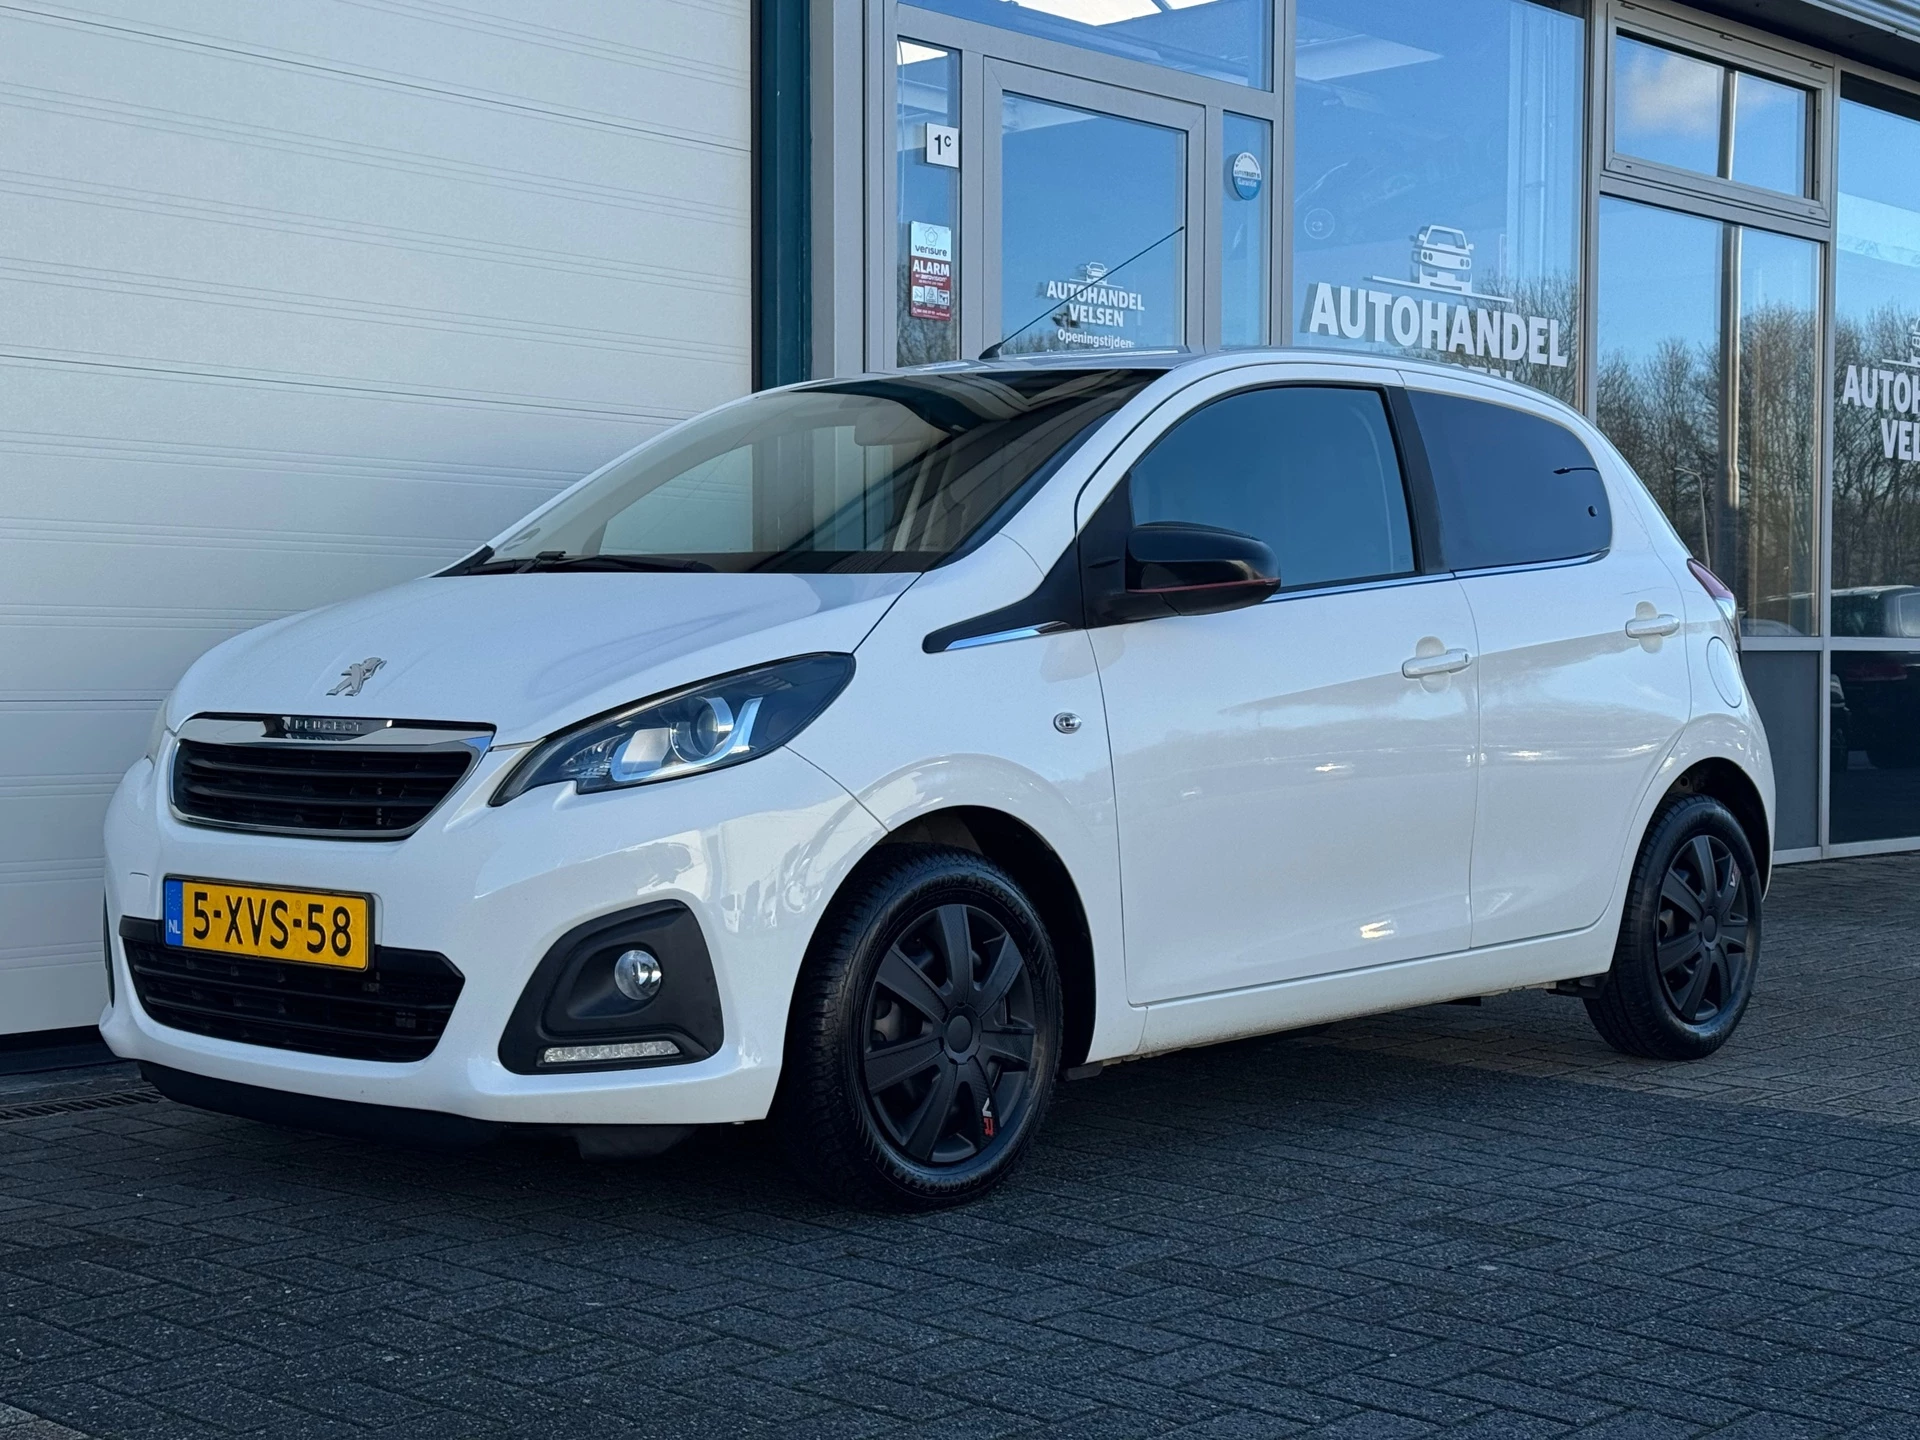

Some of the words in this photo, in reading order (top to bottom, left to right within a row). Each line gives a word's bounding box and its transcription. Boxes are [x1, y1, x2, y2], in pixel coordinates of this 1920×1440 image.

[914, 244, 948, 257] verisure
[912, 259, 950, 277] ALARM
[1046, 280, 1145, 311] AUTOHANDEL
[1069, 303, 1124, 327] VELSEN
[1309, 281, 1568, 368] AUTOHANDEL
[295, 719, 362, 732] PEUGEOT
[168, 918, 181, 934] NL
[193, 891, 353, 957] 5-XVS-58
